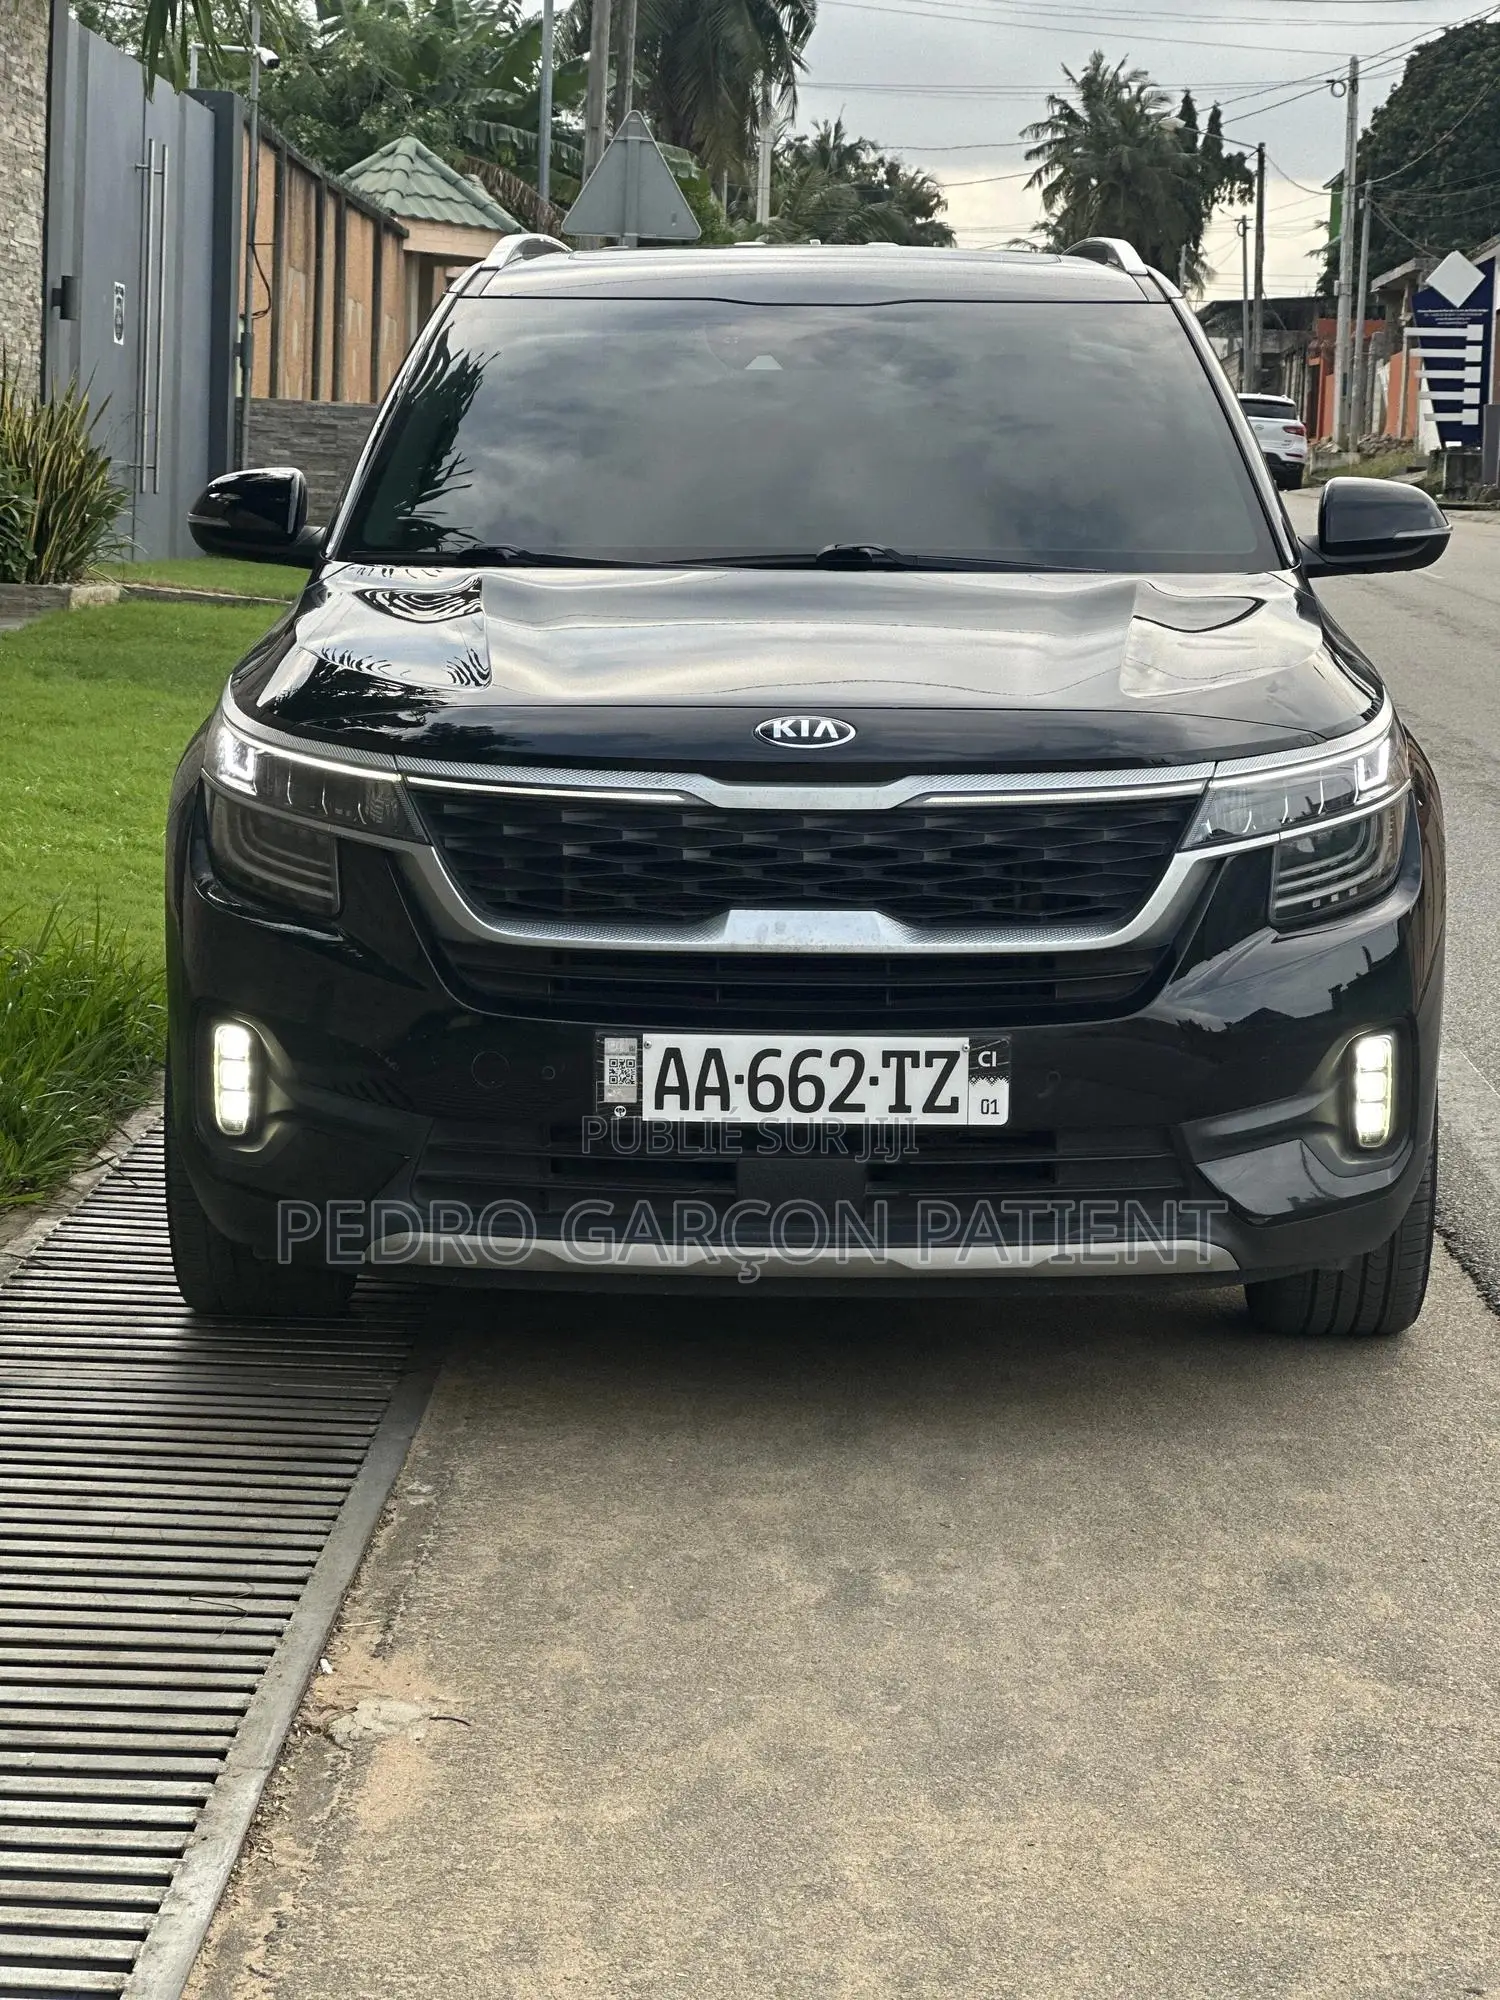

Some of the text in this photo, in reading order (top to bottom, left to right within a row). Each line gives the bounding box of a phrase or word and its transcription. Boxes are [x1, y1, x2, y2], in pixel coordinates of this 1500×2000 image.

[773, 719, 839, 739] KIA
[978, 1050, 997, 1067] CI
[980, 1098, 1000, 1115] 01
